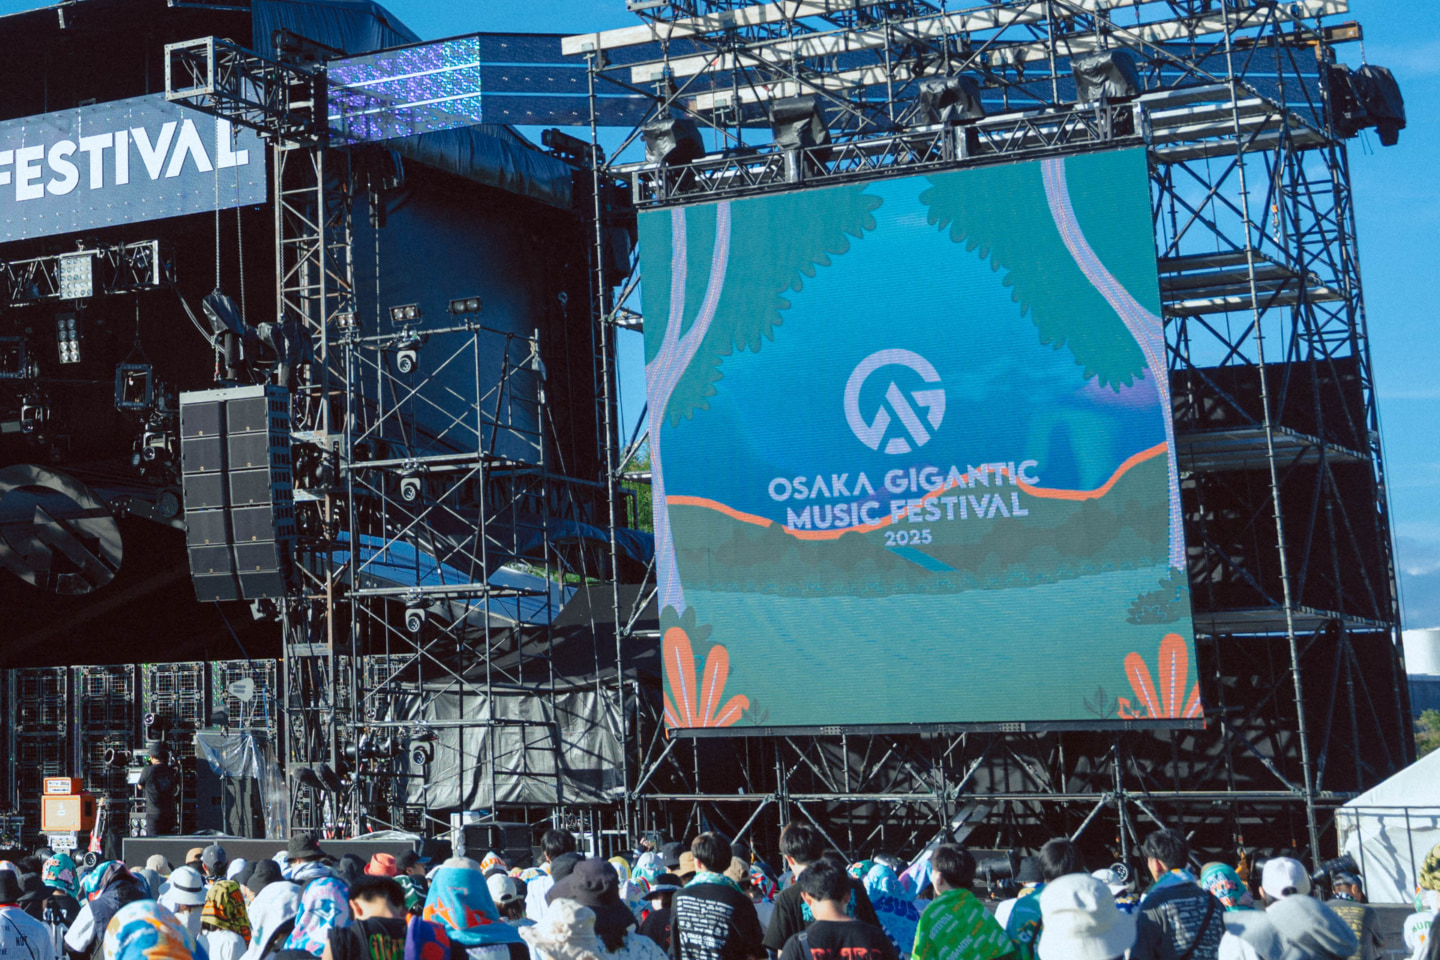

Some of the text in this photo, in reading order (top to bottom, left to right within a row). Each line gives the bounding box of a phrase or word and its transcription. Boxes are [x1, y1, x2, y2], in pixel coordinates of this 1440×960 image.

[768, 459, 1040, 501] OSAKA GIGANTIC
[787, 492, 1029, 530] MUSIC FESTIVAL
[884, 529, 932, 547] 2025
